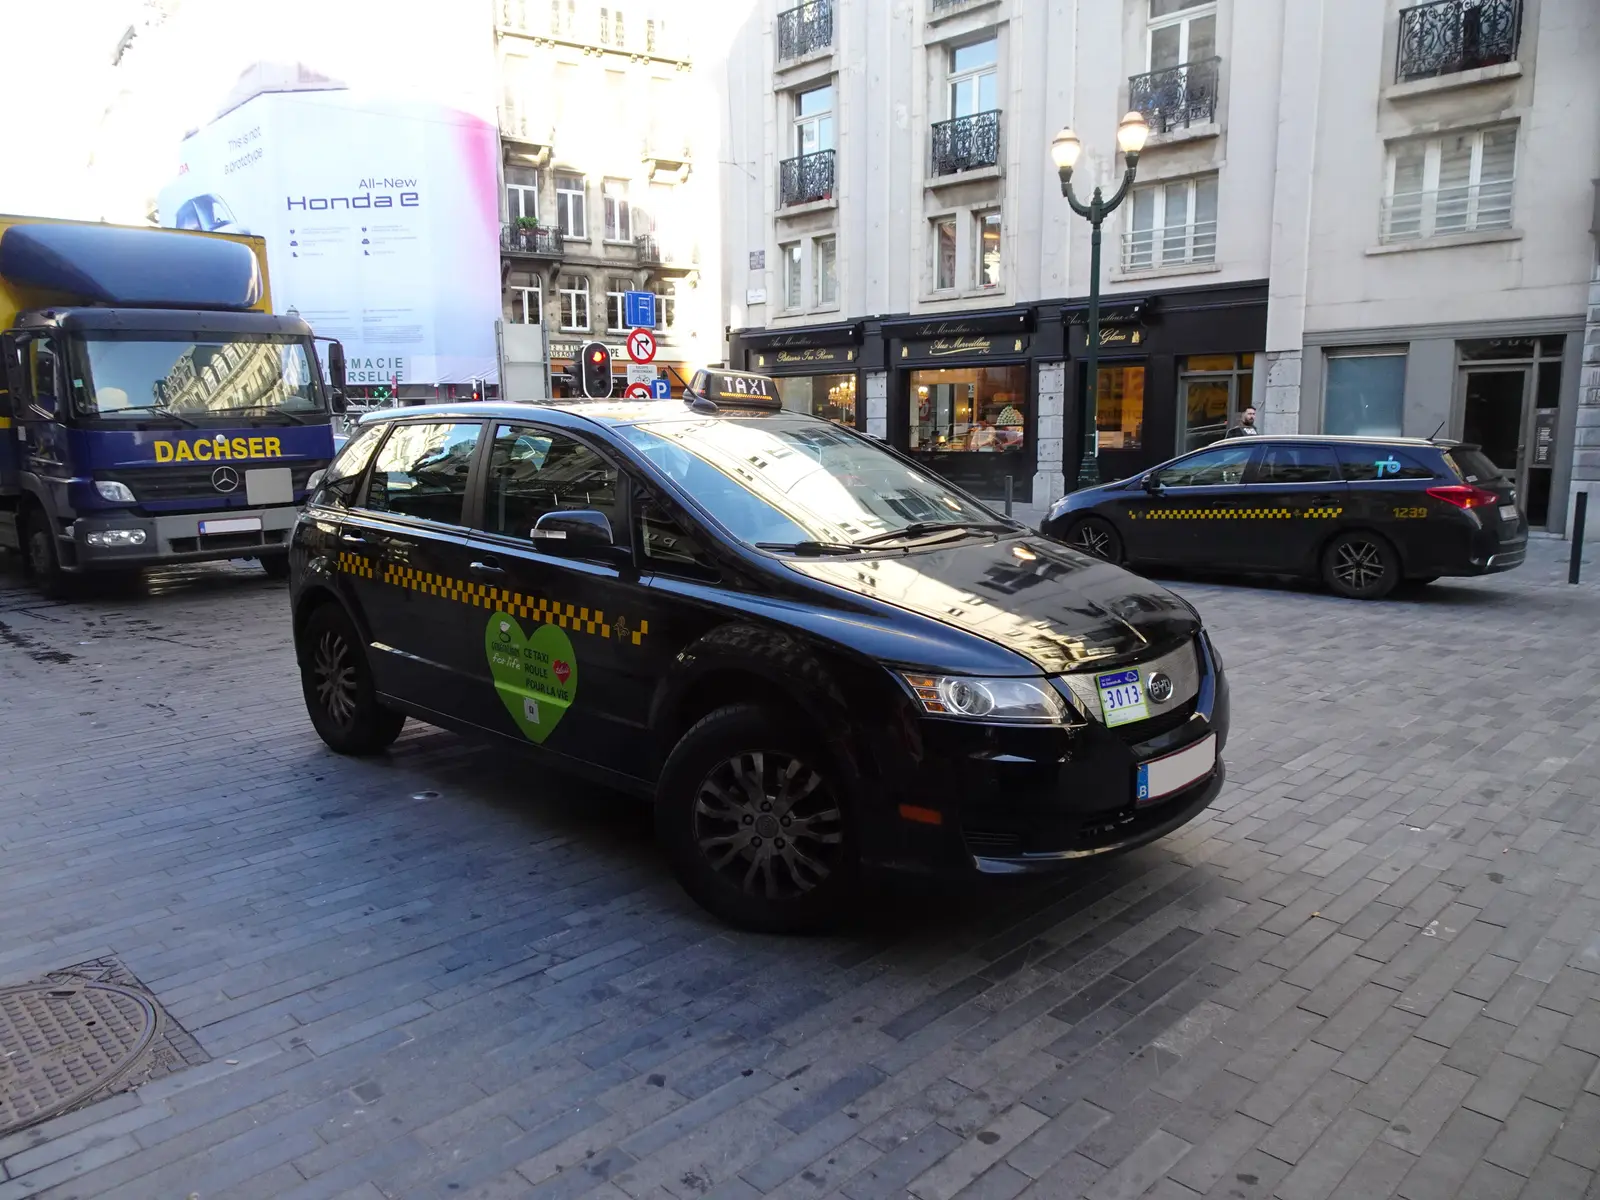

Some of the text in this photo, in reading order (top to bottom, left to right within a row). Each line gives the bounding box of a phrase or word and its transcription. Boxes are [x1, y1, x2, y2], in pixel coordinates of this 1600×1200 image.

[358, 177, 418, 189] All-New
[287, 193, 393, 211] Honda
[656, 381, 668, 399] P
[723, 376, 767, 396] TAXI
[154, 439, 281, 462] DACHSER
[1392, 507, 1428, 519] 1239
[492, 652, 521, 670] for life
[524, 664, 548, 678] ROULE
[525, 677, 569, 701] POUR LA VIE
[1151, 678, 1171, 696] BYD
[1107, 686, 1139, 708] 3013
[1139, 785, 1148, 797] B
